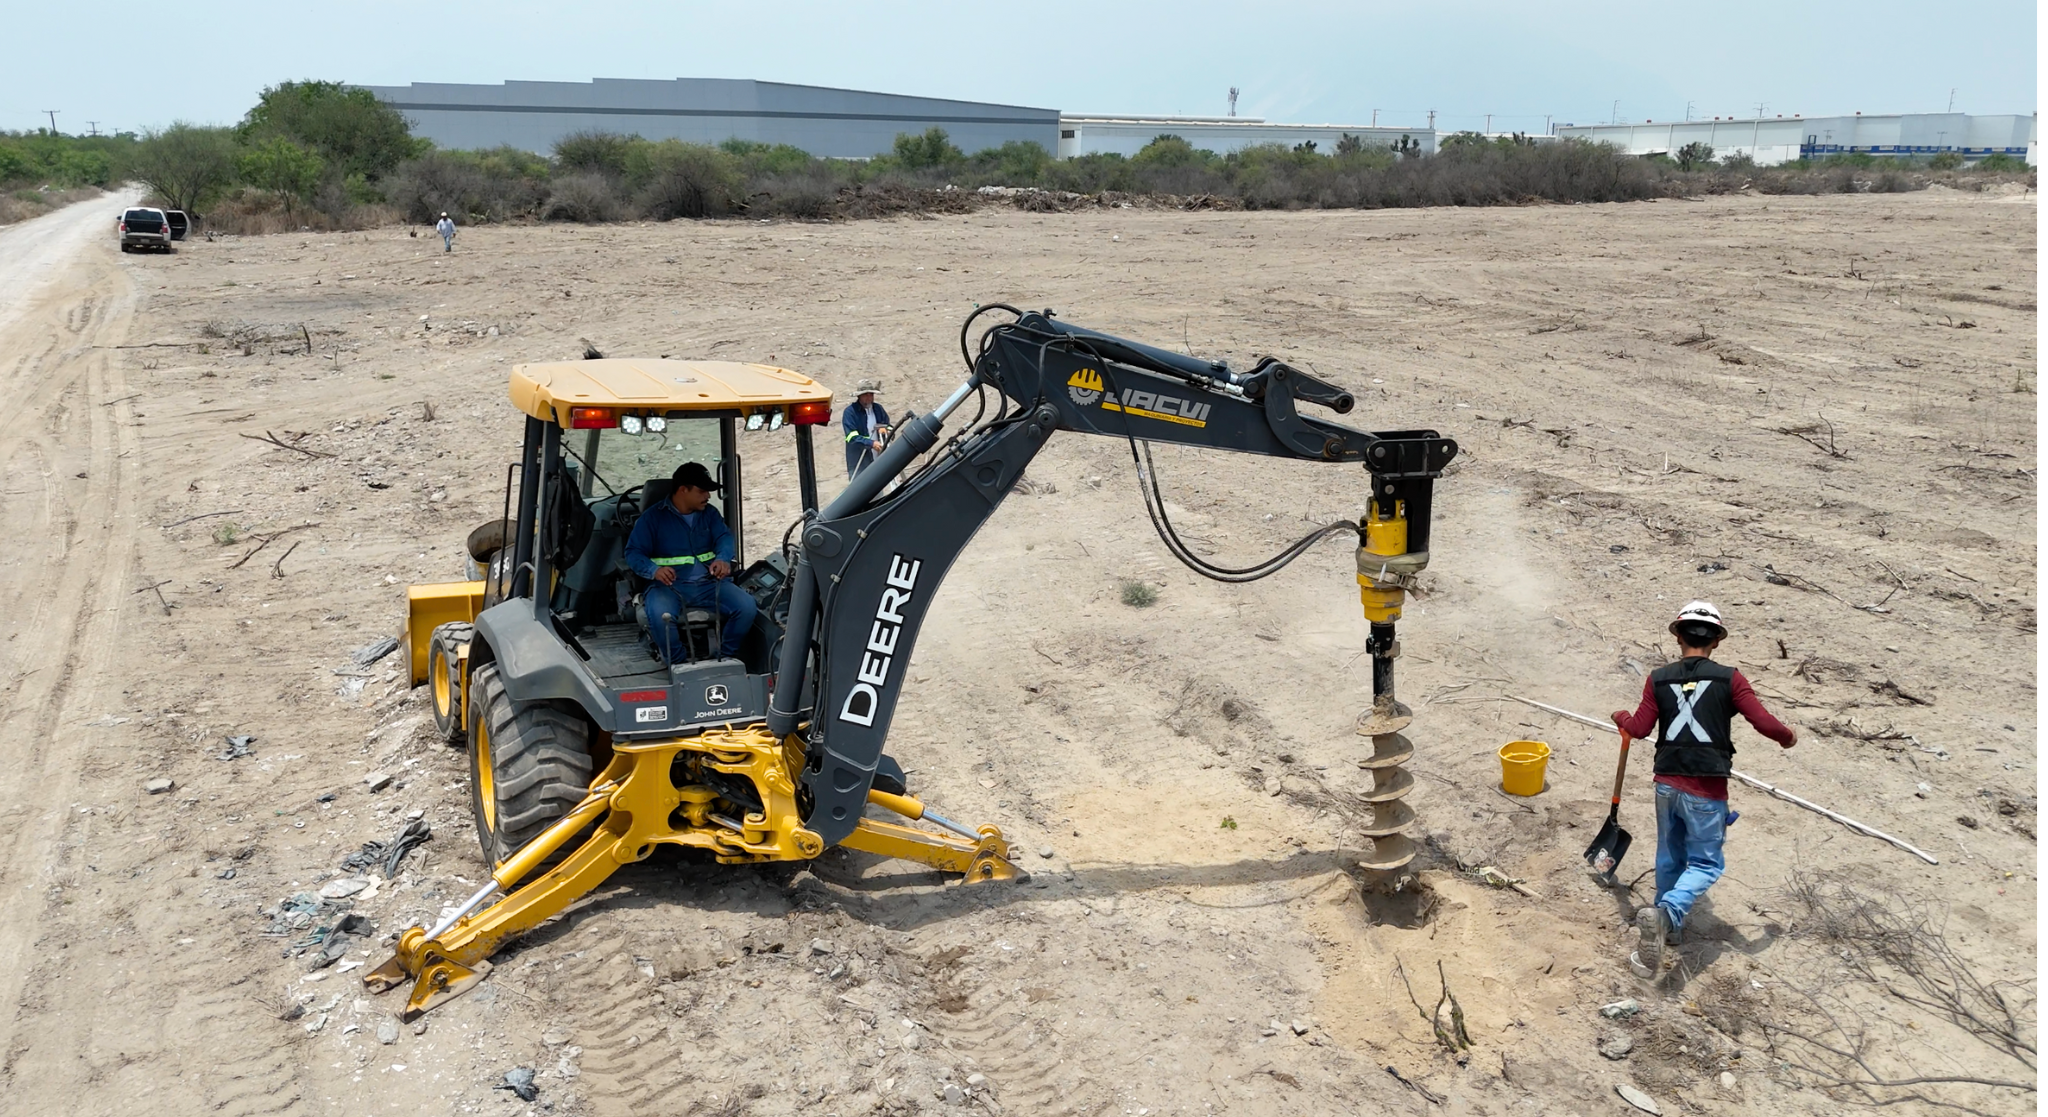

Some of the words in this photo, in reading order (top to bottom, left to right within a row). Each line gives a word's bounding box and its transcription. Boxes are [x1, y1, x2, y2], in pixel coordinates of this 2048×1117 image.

[839, 554, 921, 727] DEERE
[694, 710, 716, 719] JOHN
[717, 707, 742, 716] DEERE
